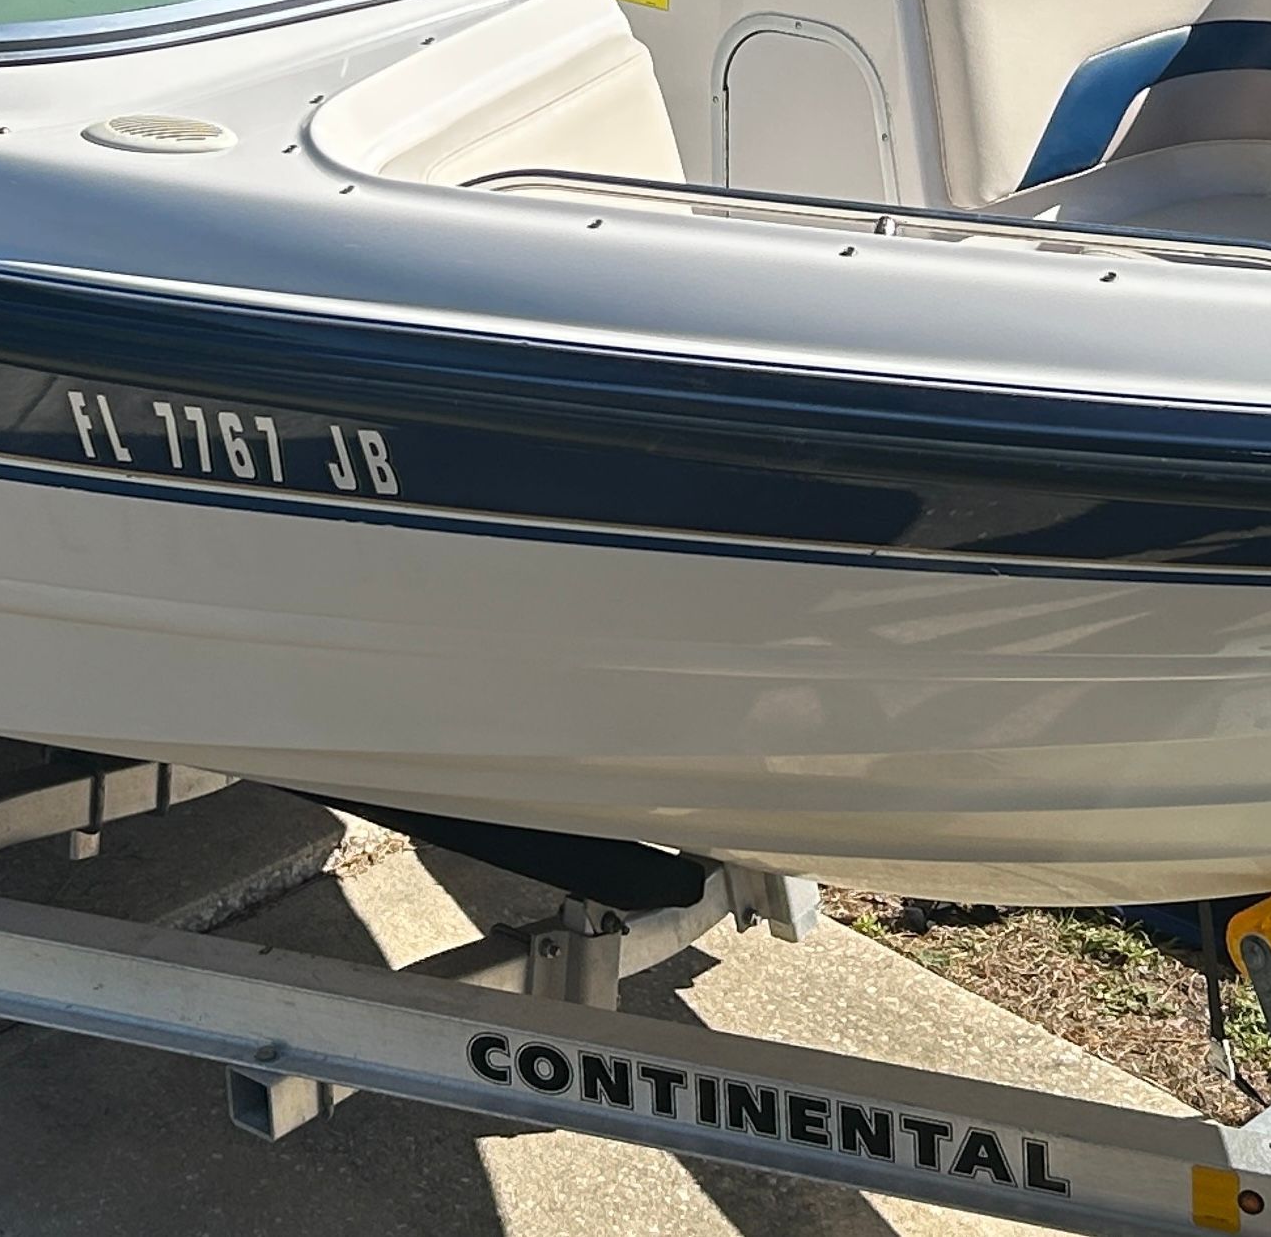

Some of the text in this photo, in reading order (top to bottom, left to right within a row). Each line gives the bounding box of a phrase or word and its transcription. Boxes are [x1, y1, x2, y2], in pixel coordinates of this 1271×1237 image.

[67, 390, 399, 496] FL 7767 JB
[466, 1031, 1072, 1198] CONTINENTAL
